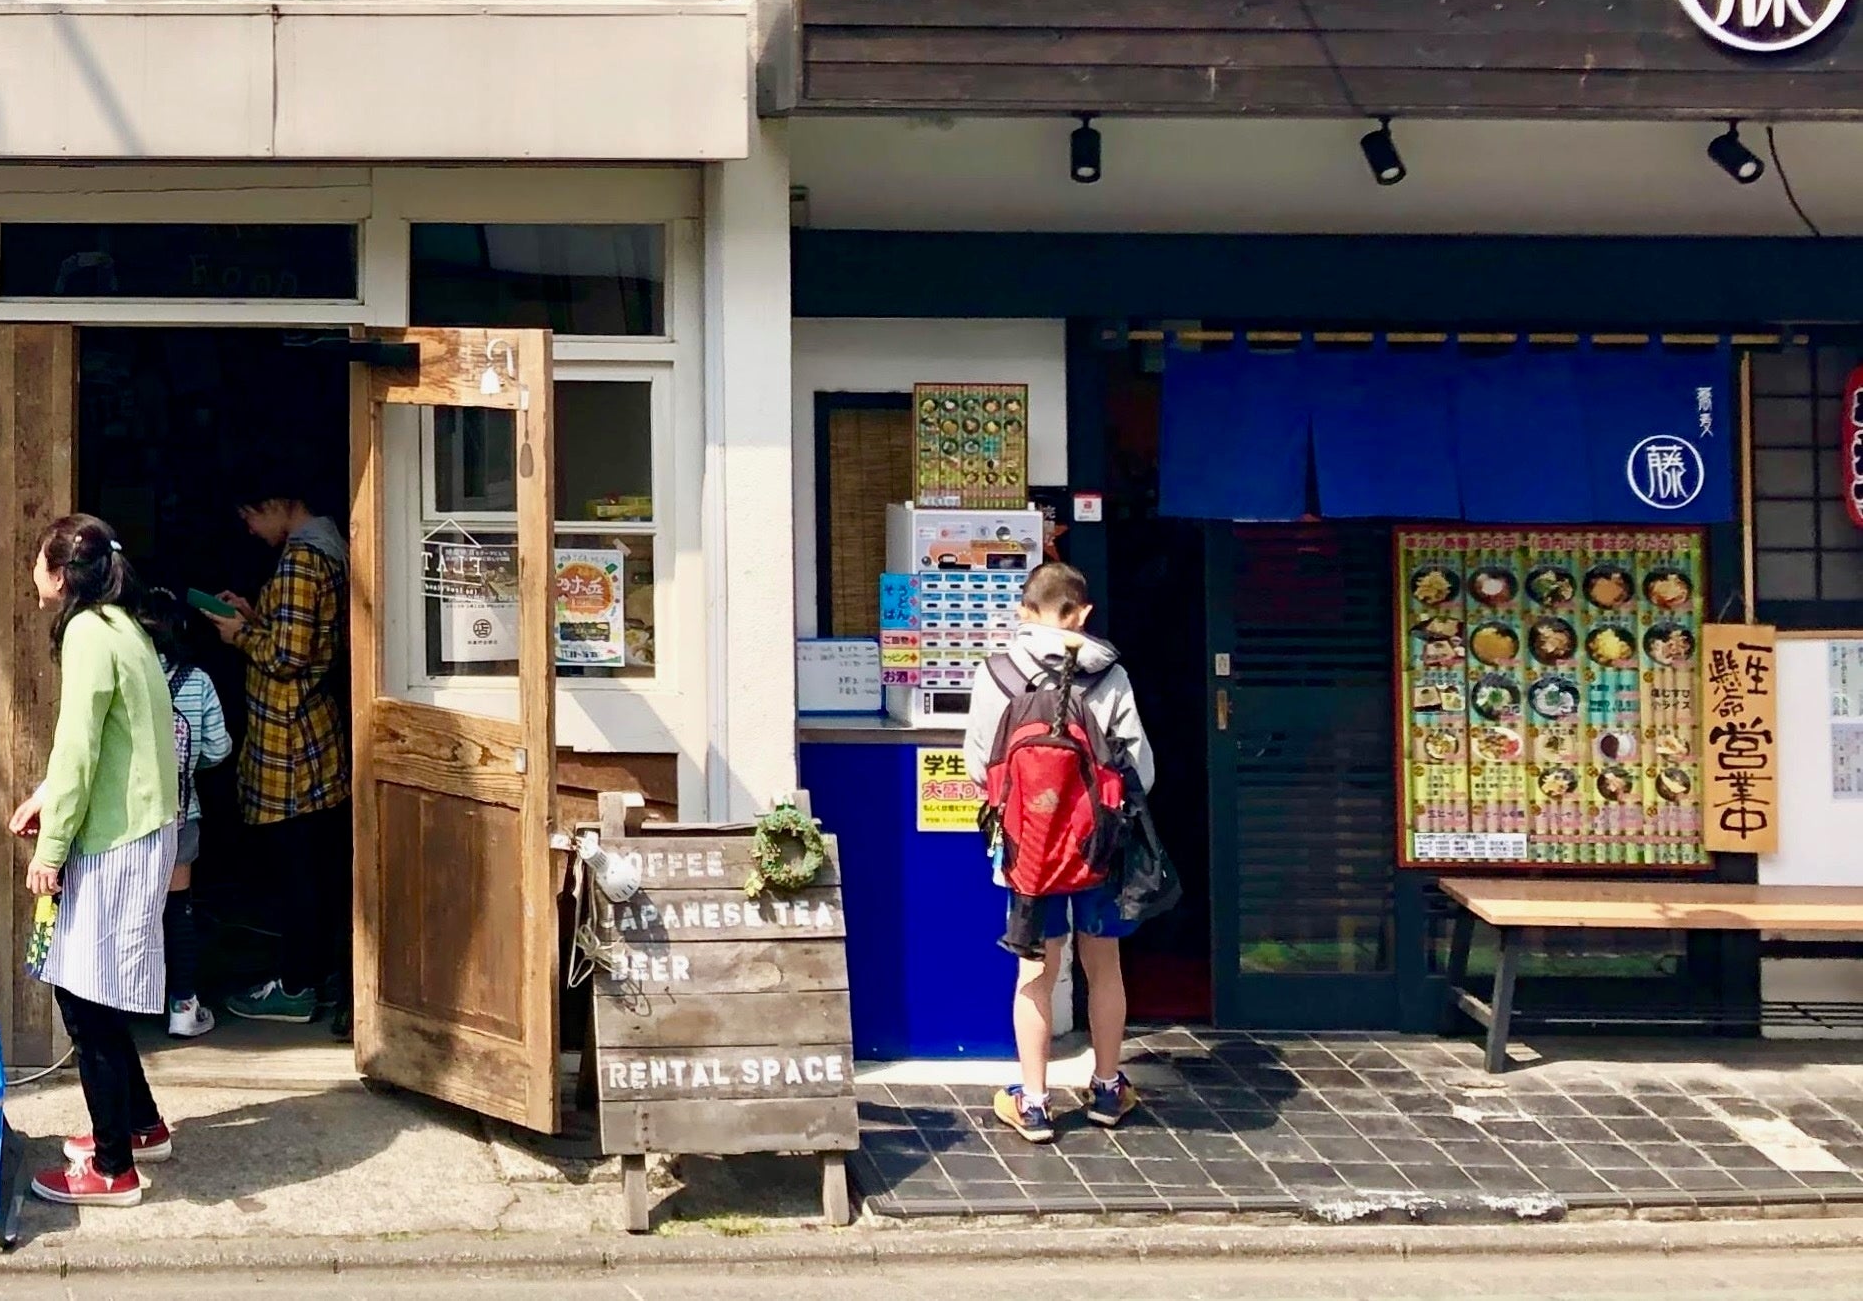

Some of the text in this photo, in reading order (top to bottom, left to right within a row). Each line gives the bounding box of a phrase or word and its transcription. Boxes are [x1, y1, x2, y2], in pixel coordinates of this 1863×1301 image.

[1645, 444, 1688, 499] 藤
[883, 670, 909, 683] お酒
[923, 754, 967, 776] 学生
[1708, 716, 1774, 840] 営業中
[605, 850, 725, 878] OFFEE
[600, 898, 835, 932] JAPANESE TEA
[610, 952, 691, 982] BEER
[608, 1055, 845, 1090] RENTAL SPACE
